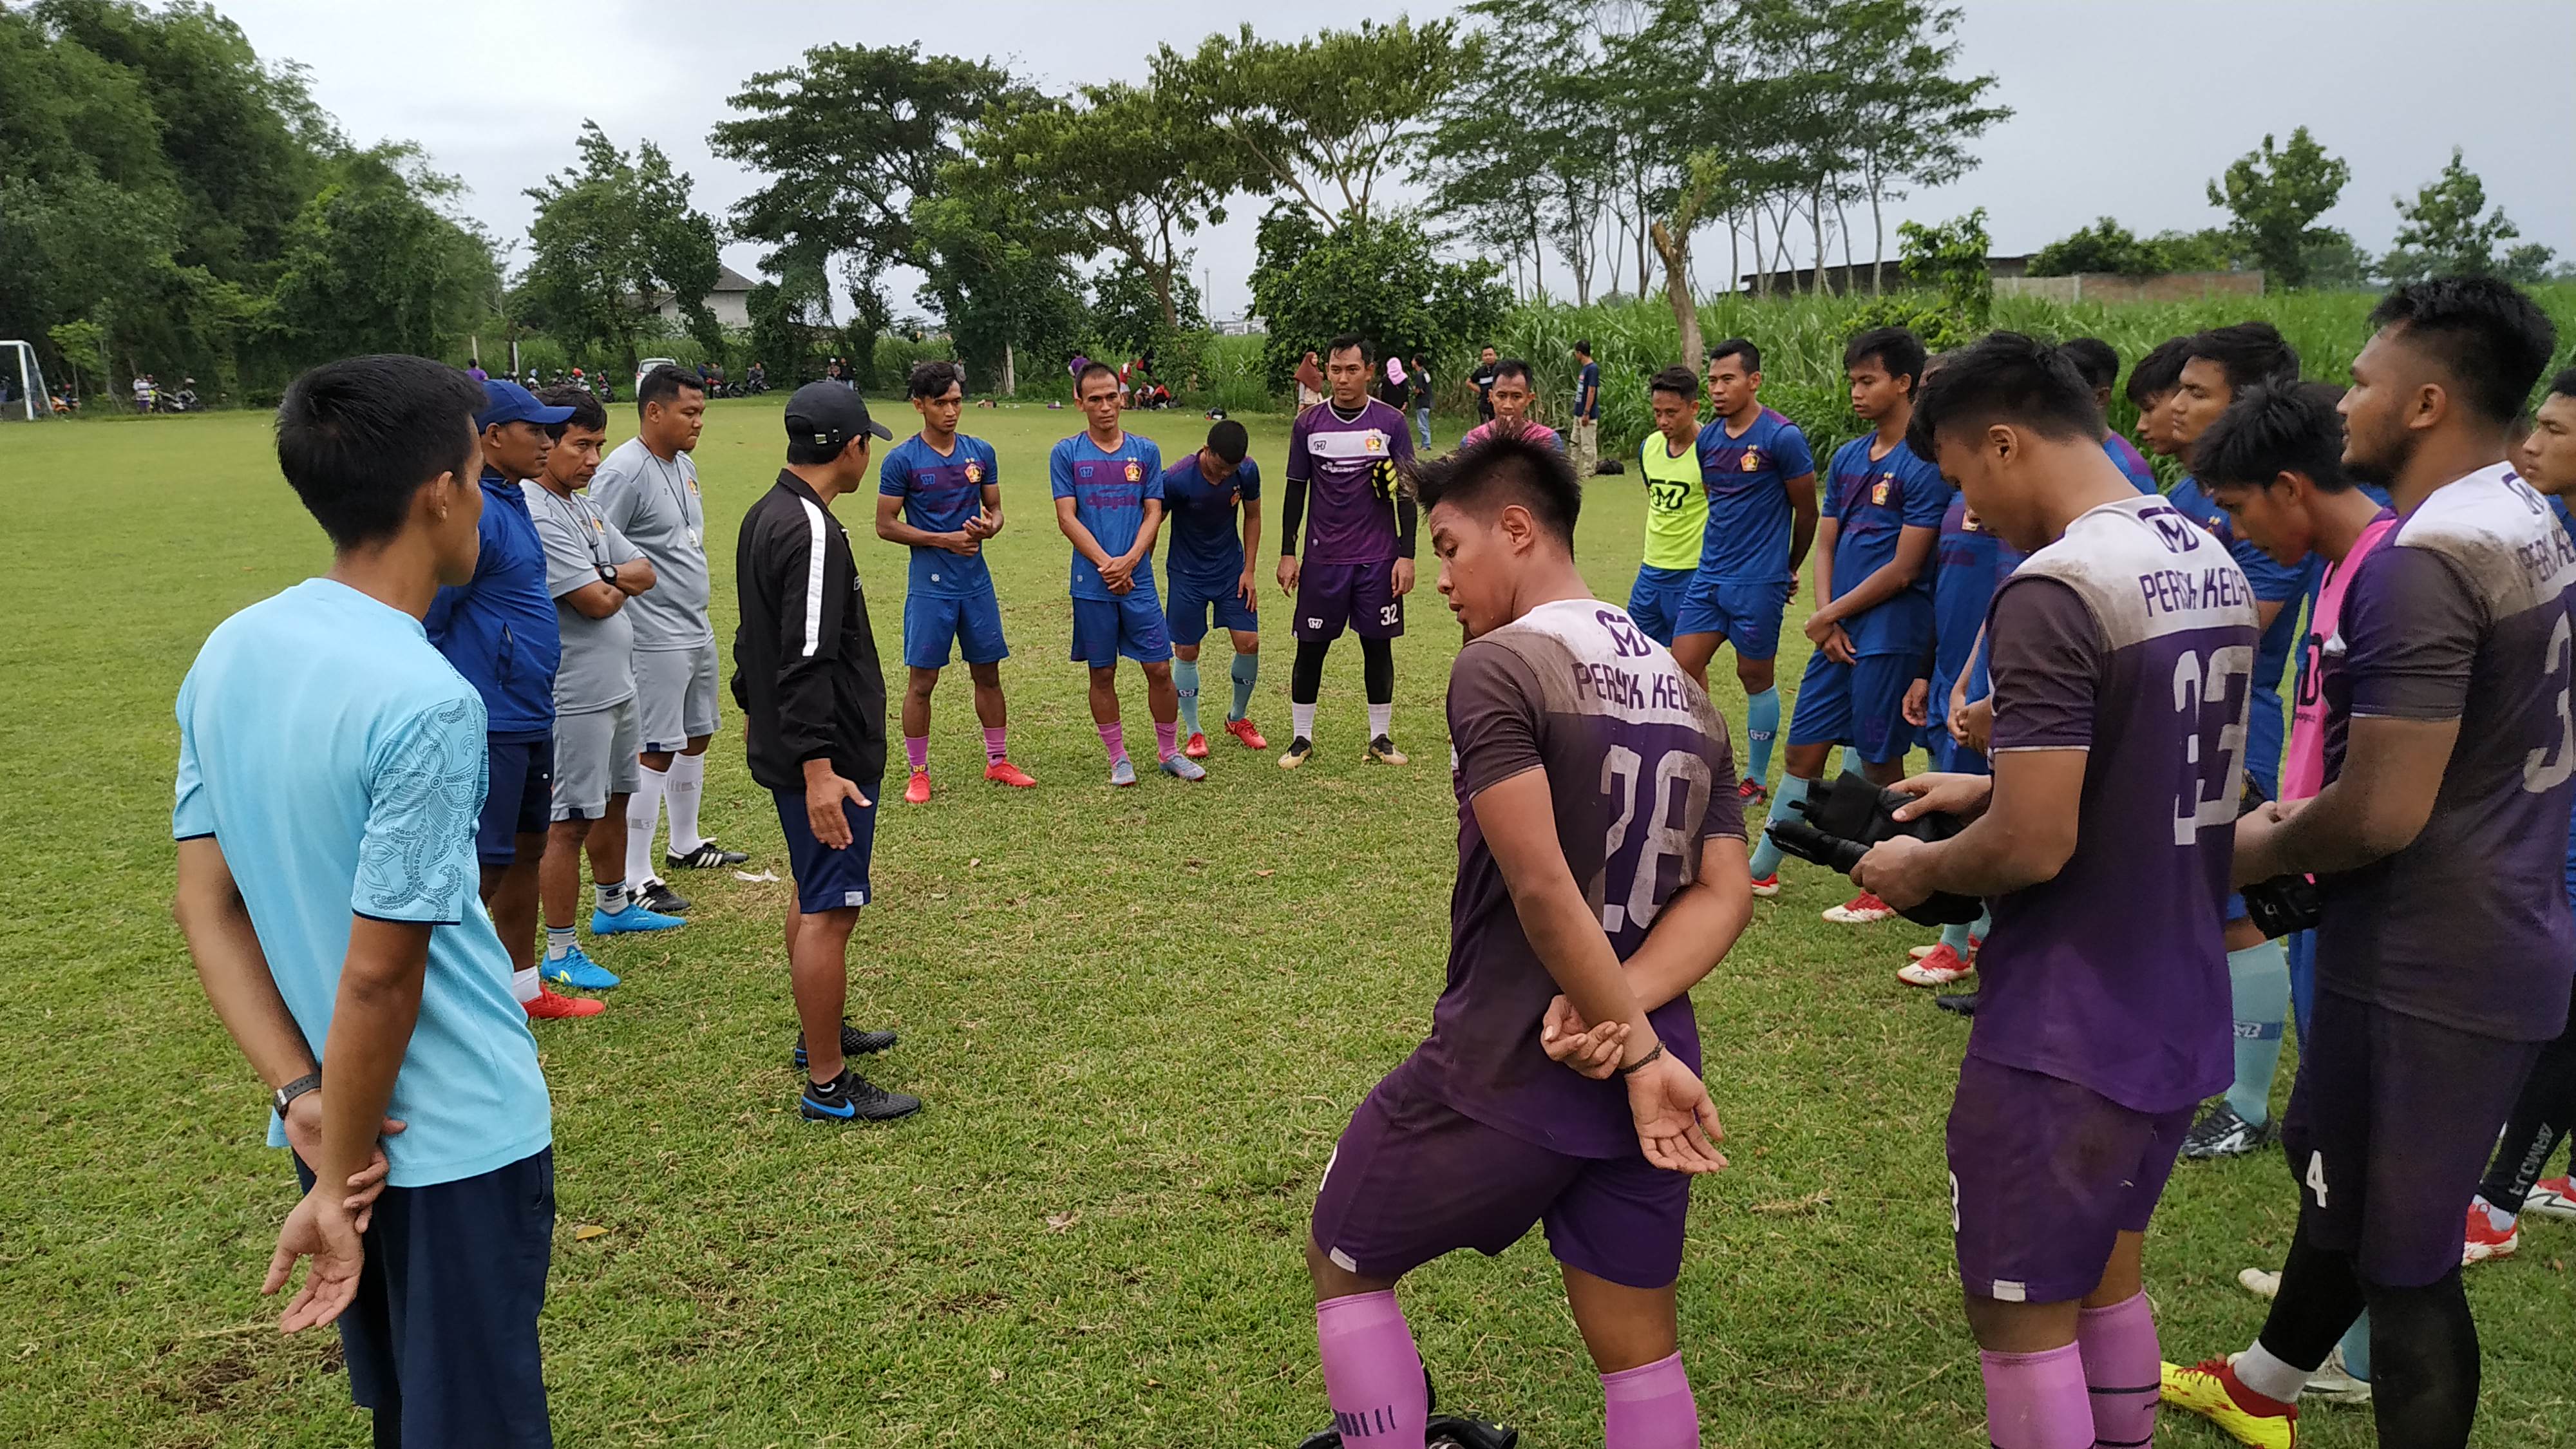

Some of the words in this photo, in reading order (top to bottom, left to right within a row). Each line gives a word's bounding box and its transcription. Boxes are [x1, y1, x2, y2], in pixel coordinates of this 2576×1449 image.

[1380, 603, 1399, 626] 32
[1587, 744, 1711, 933] 28
[2306, 1150, 2328, 1208] 4
